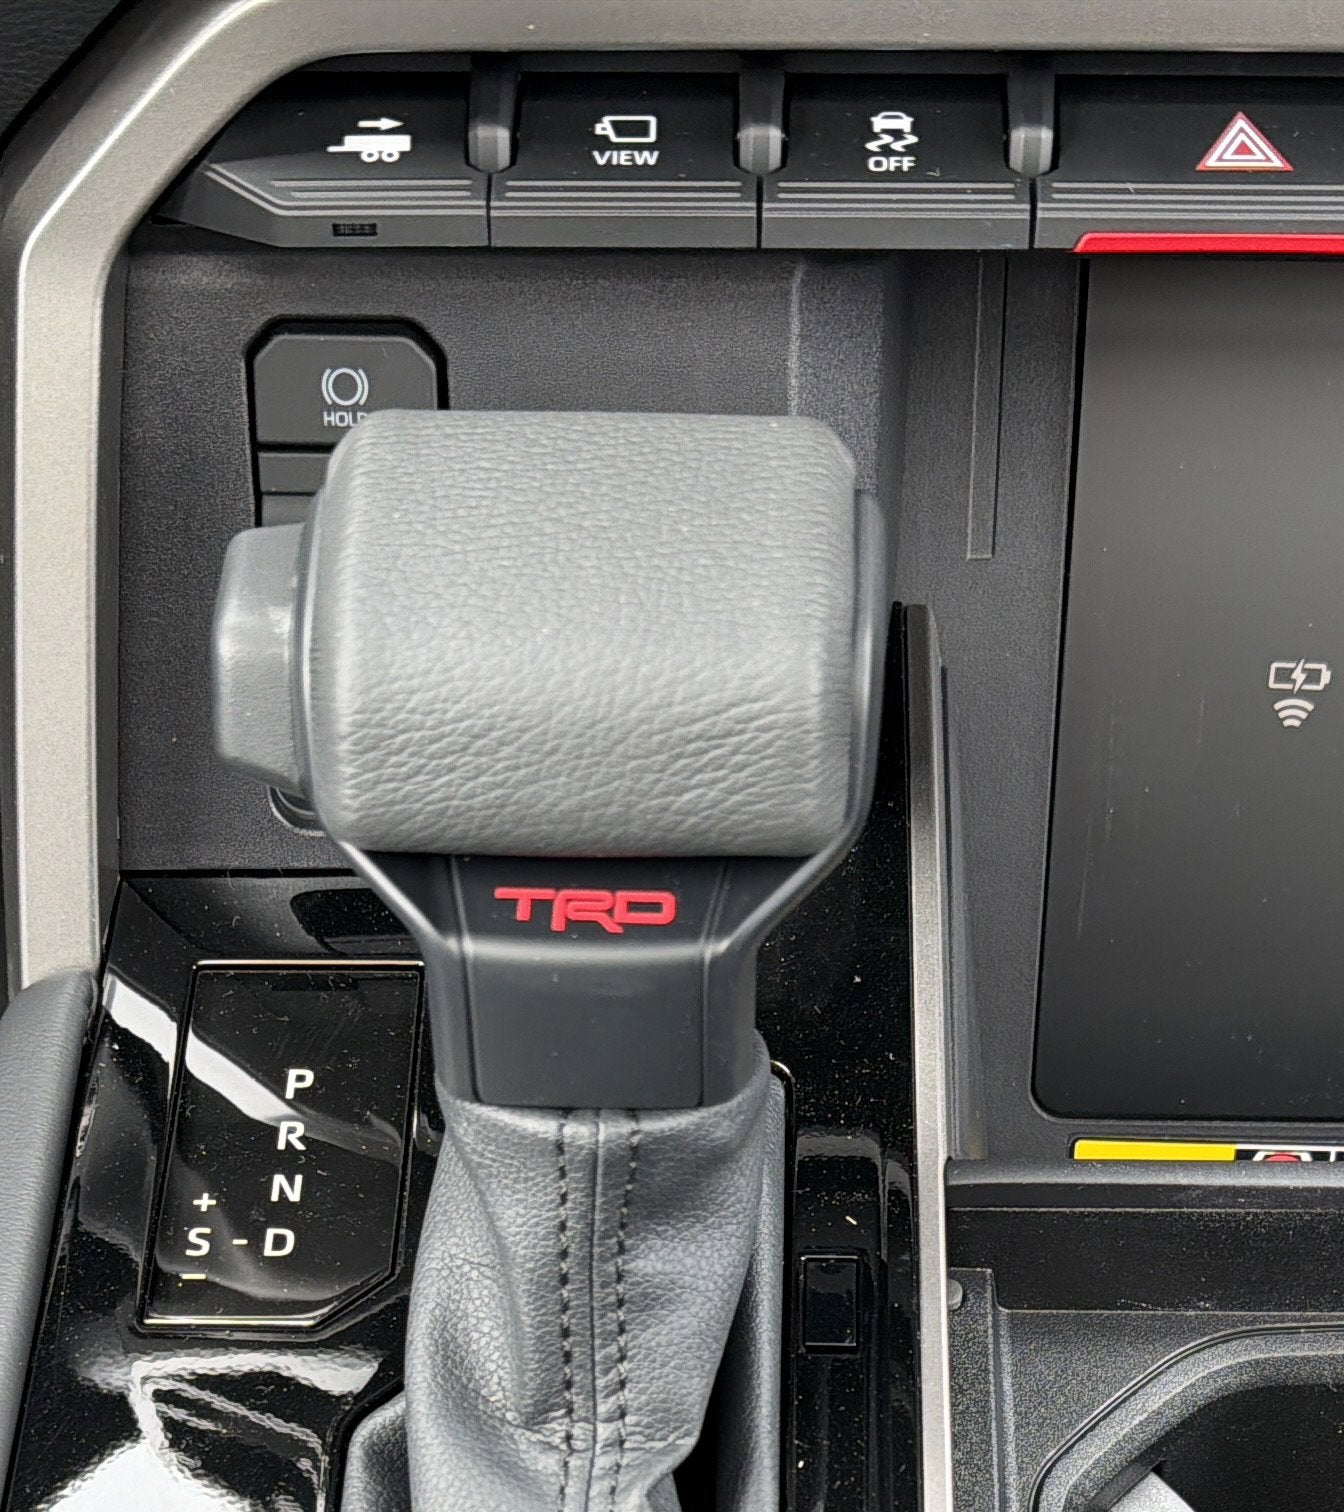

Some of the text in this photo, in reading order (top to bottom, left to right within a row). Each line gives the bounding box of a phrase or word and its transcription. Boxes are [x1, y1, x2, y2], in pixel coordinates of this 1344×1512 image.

[592, 149, 660, 166] VIEW
[868, 156, 916, 172] OFF
[495, 887, 677, 934] TRD
[285, 1068, 315, 1101] P
[276, 1120, 306, 1151] R
[270, 1173, 304, 1202] N
